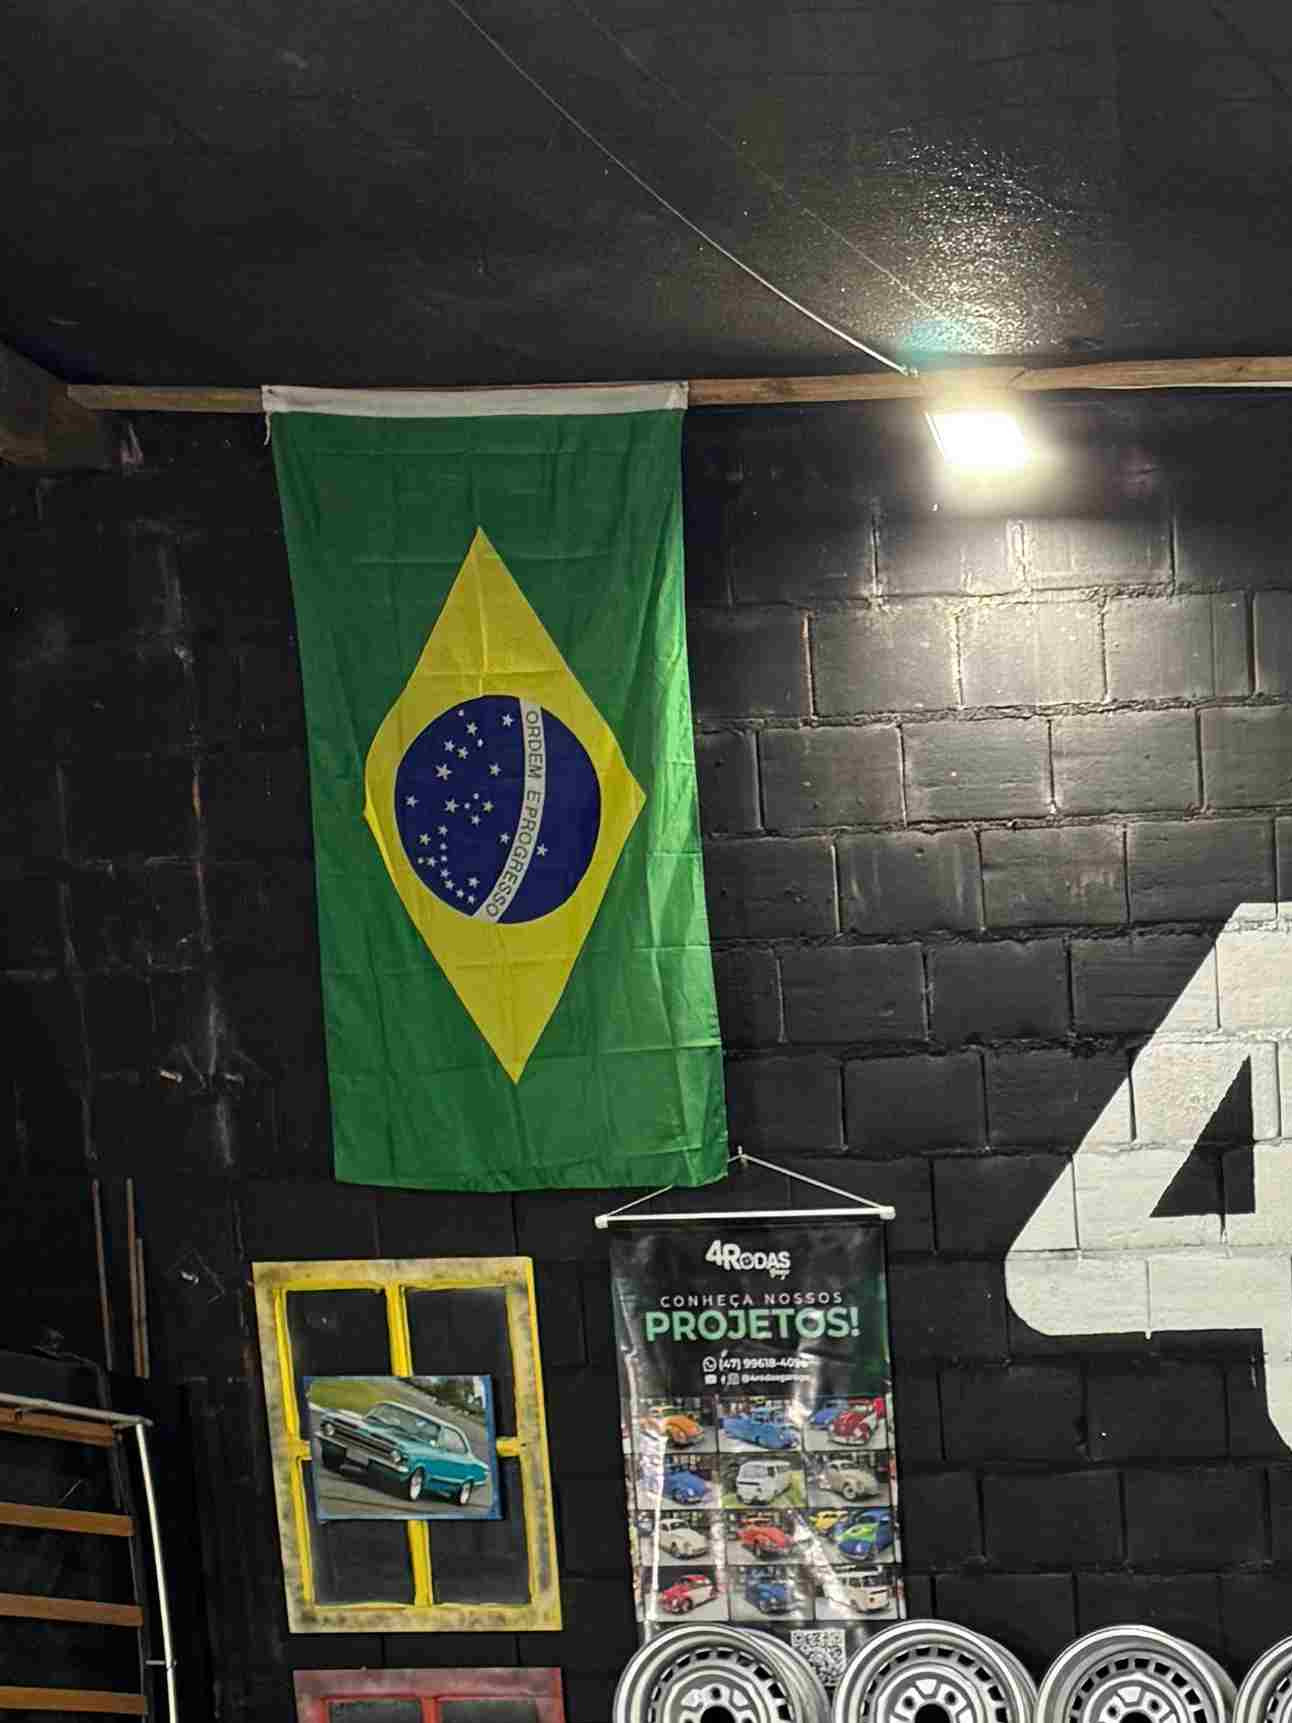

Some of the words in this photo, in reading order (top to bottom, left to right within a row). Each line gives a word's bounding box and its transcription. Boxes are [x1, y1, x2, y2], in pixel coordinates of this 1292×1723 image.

[525, 709, 544, 780] ORDEM
[526, 790, 541, 803] E
[485, 804, 538, 918] PROGRESSO
[705, 1239, 792, 1271] 4RODAS
[660, 1294, 754, 1309] CONHEÇA
[764, 1291, 843, 1304] NOSSOS
[645, 1306, 861, 1342] PROJETOS!
